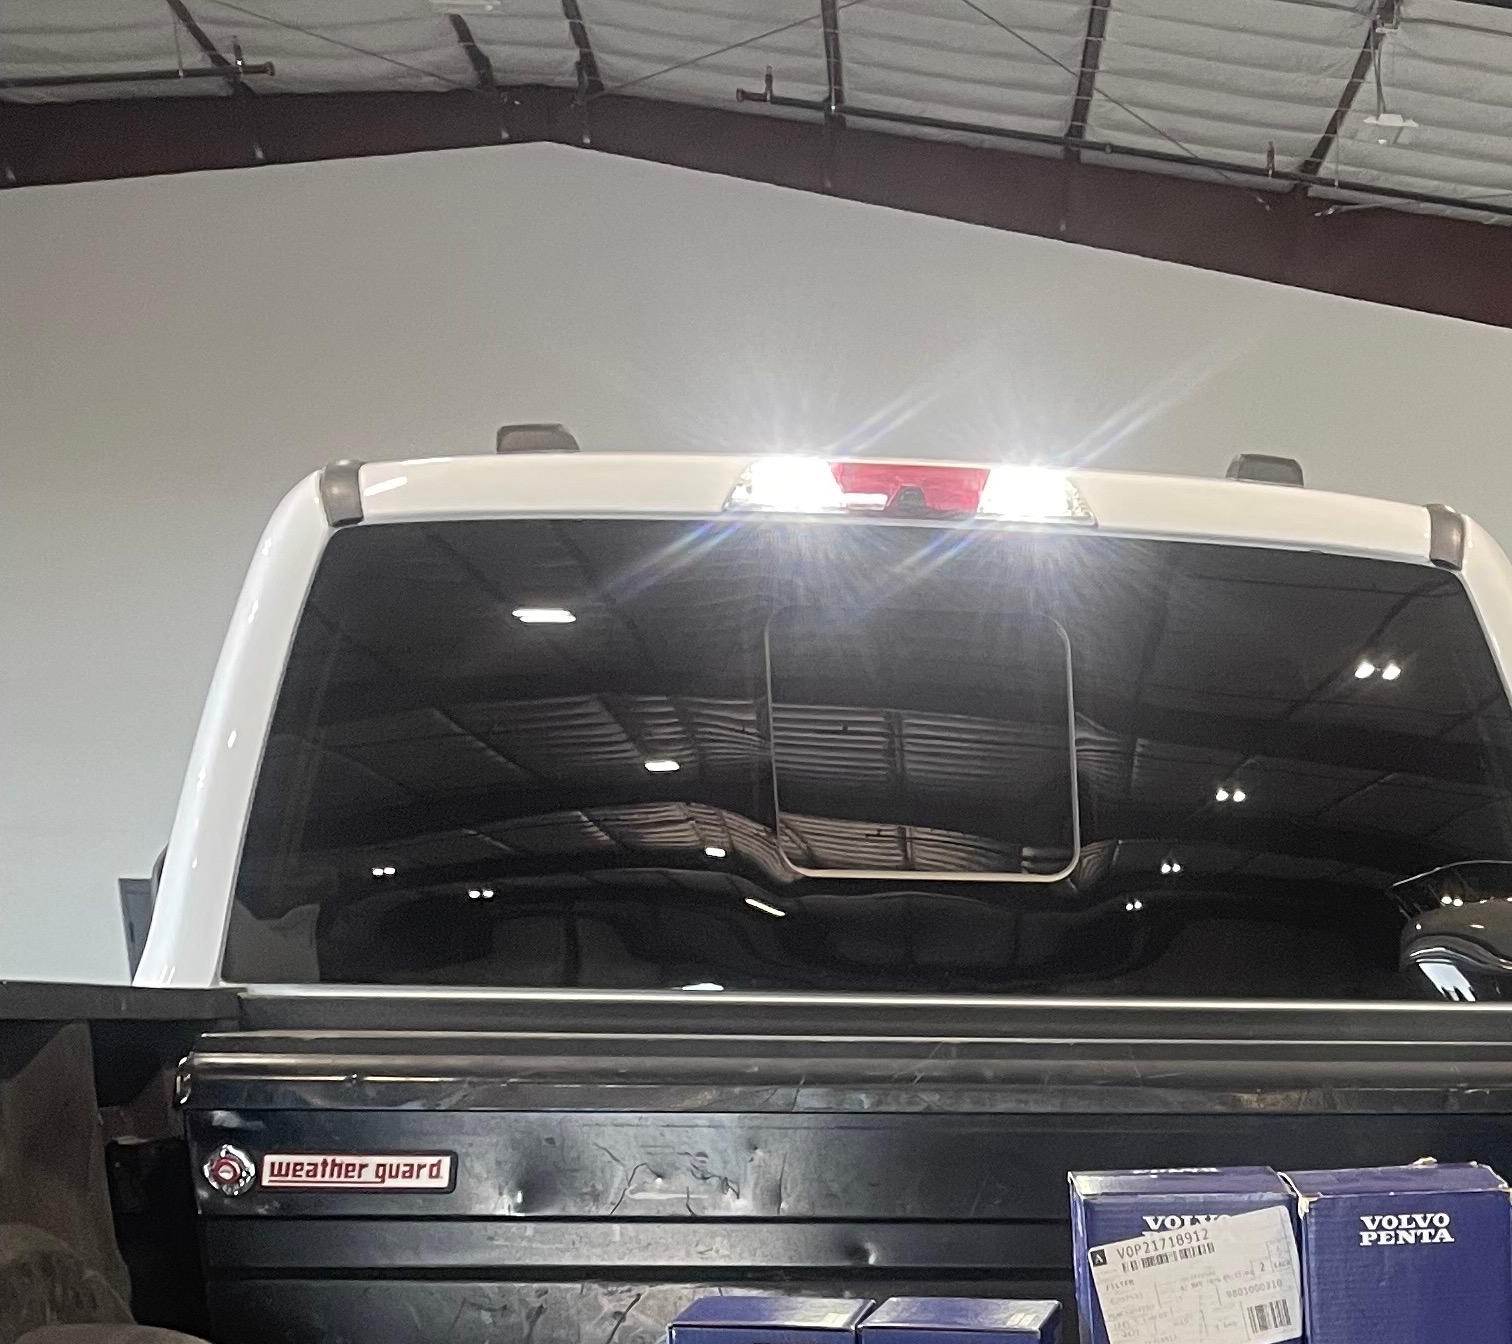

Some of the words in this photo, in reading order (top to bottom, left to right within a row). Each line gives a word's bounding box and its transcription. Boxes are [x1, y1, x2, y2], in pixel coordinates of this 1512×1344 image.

[268, 1158, 369, 1180] weather
[374, 1159, 444, 1184] guard
[1142, 1214, 1233, 1231] VOLV
[1359, 1212, 1451, 1230] VOLVO
[1359, 1228, 1455, 1246] PENTA
